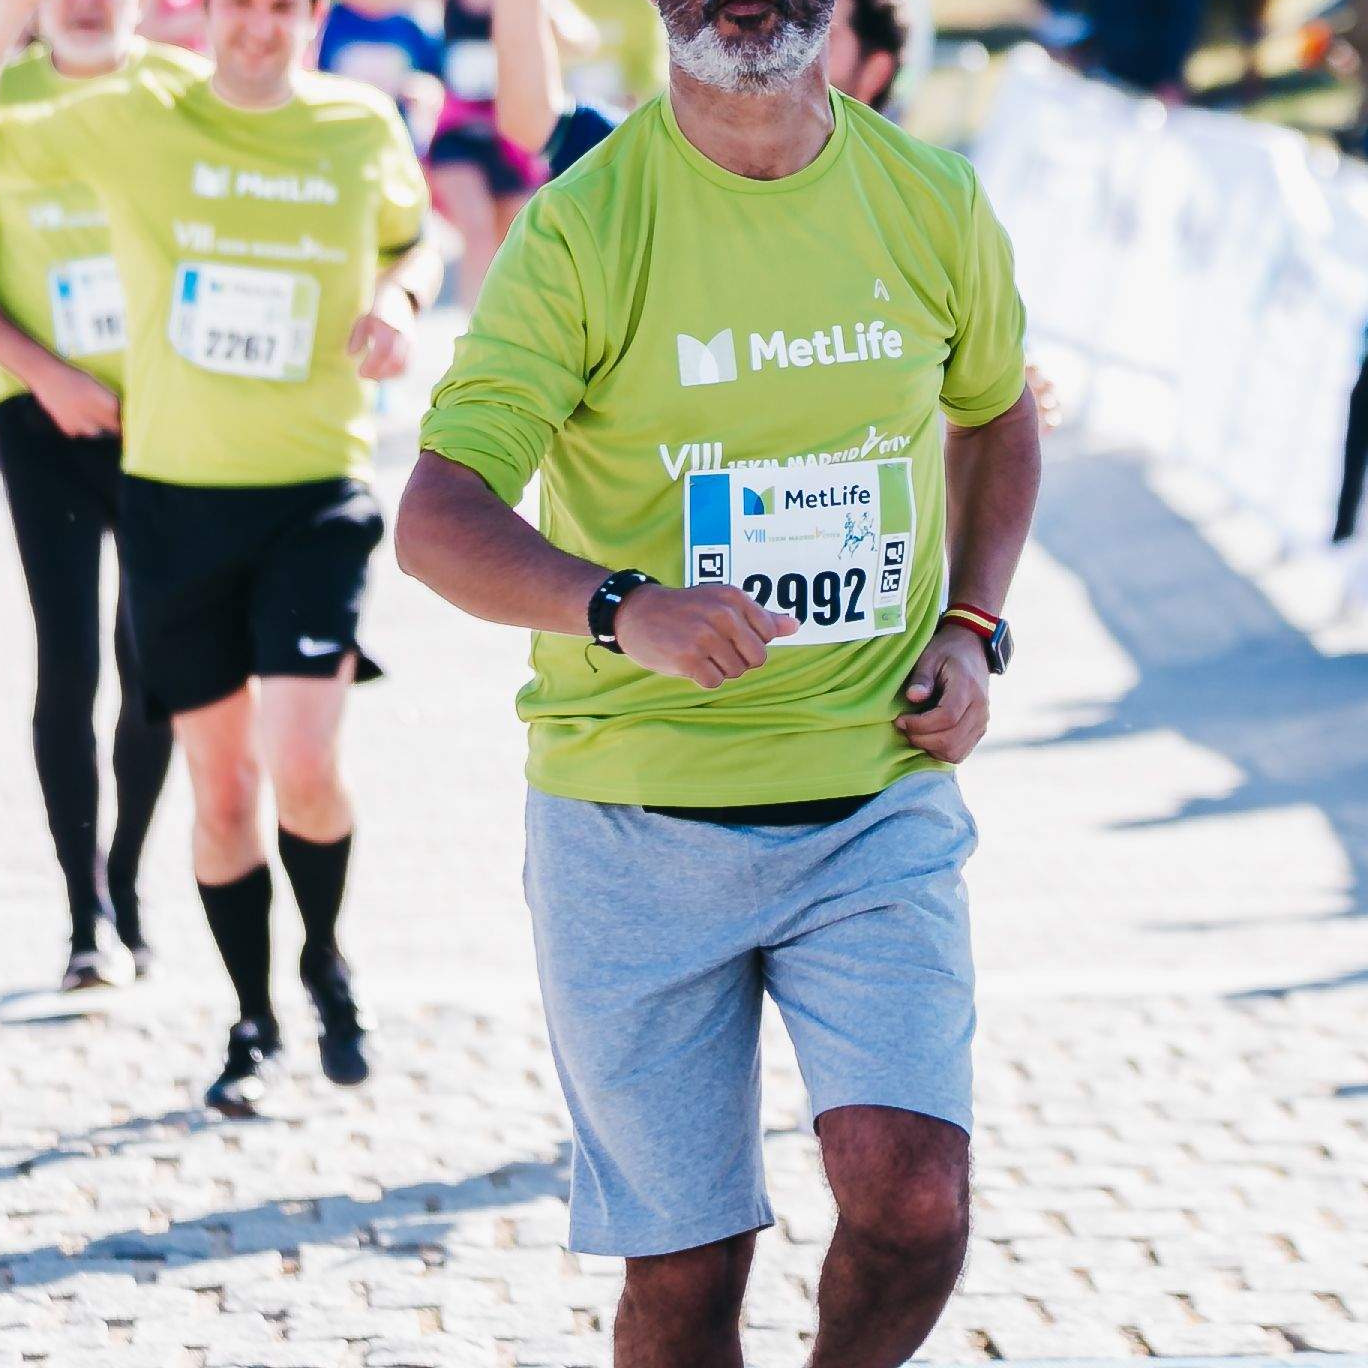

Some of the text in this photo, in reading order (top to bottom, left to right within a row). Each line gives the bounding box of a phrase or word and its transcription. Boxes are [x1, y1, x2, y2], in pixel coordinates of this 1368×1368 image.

[749, 320, 903, 370] MetLife
[659, 442, 723, 482] VIII
[785, 485, 871, 510] MetLife
[742, 567, 868, 627] 2992
